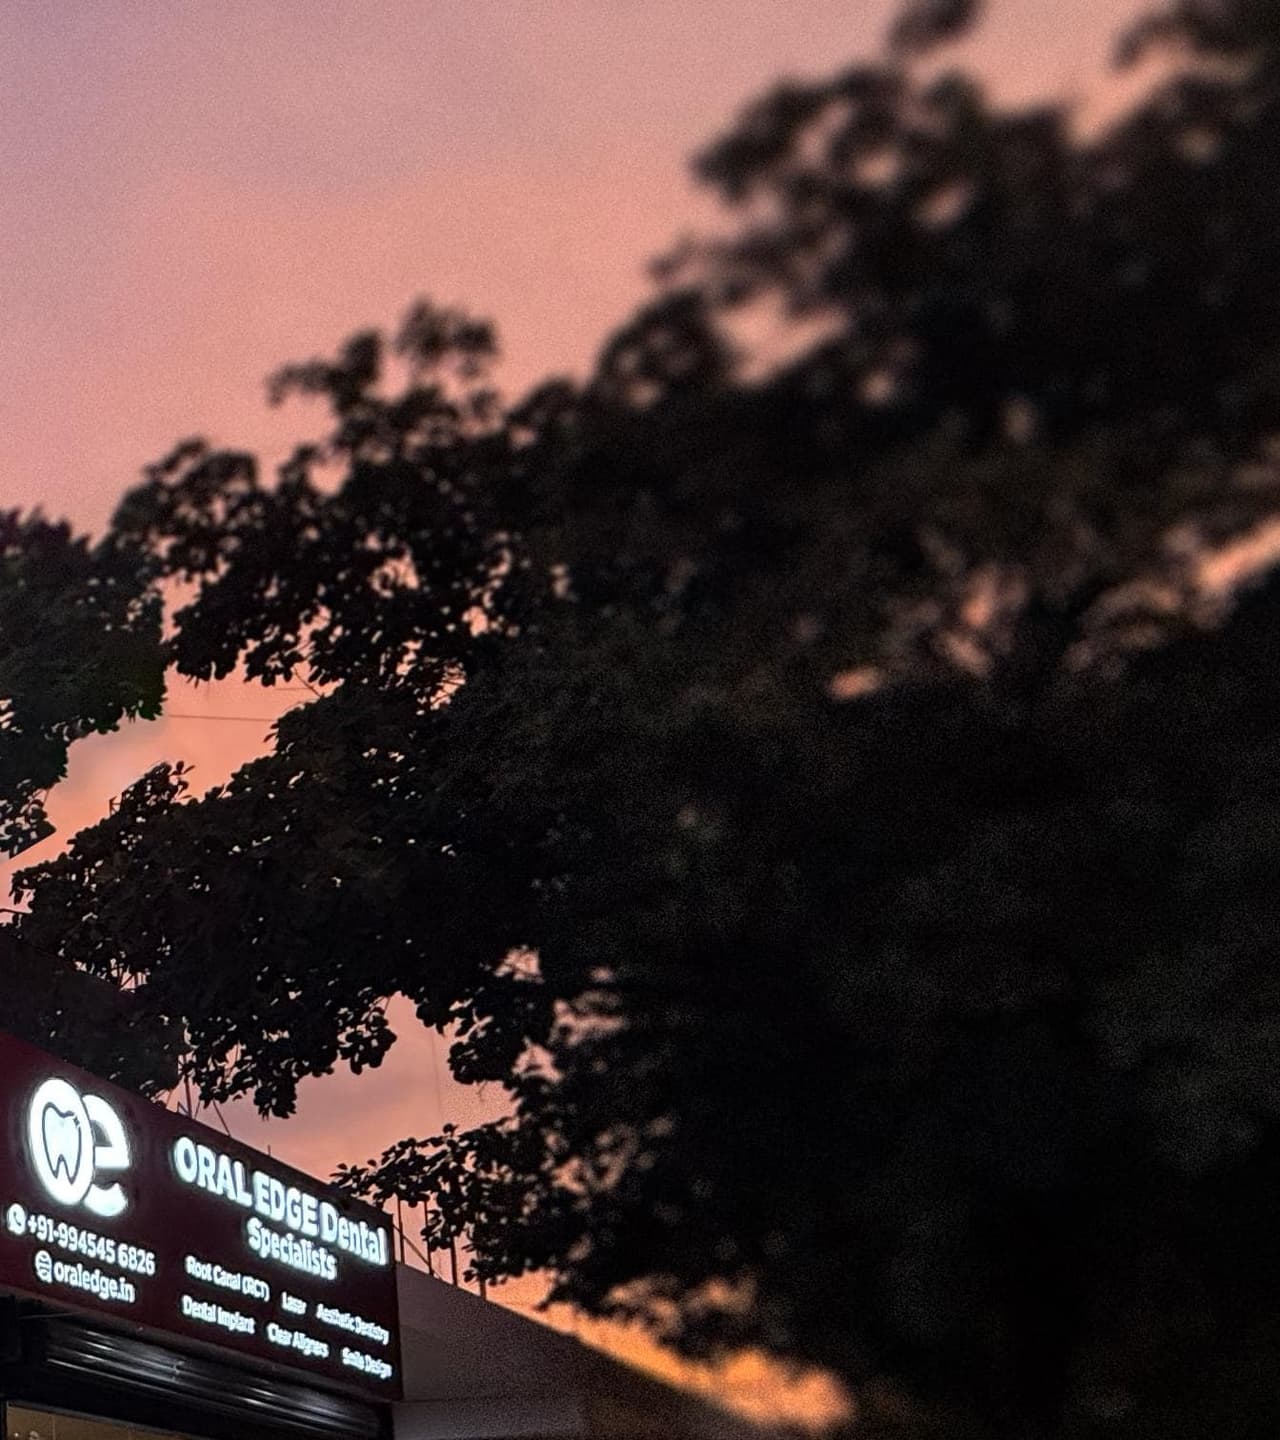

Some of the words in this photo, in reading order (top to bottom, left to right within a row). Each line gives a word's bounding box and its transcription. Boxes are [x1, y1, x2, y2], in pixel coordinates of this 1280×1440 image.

[173, 1136, 252, 1208] ORAL
[252, 1170, 320, 1237] EDGE
[320, 1200, 388, 1266] Dental
[27, 1214, 116, 1264] +91-994545
[117, 1243, 155, 1276] 6826
[247, 1217, 338, 1280] Specialists
[53, 1262, 135, 1303] oraledge.in
[182, 1295, 216, 1323] Dental
